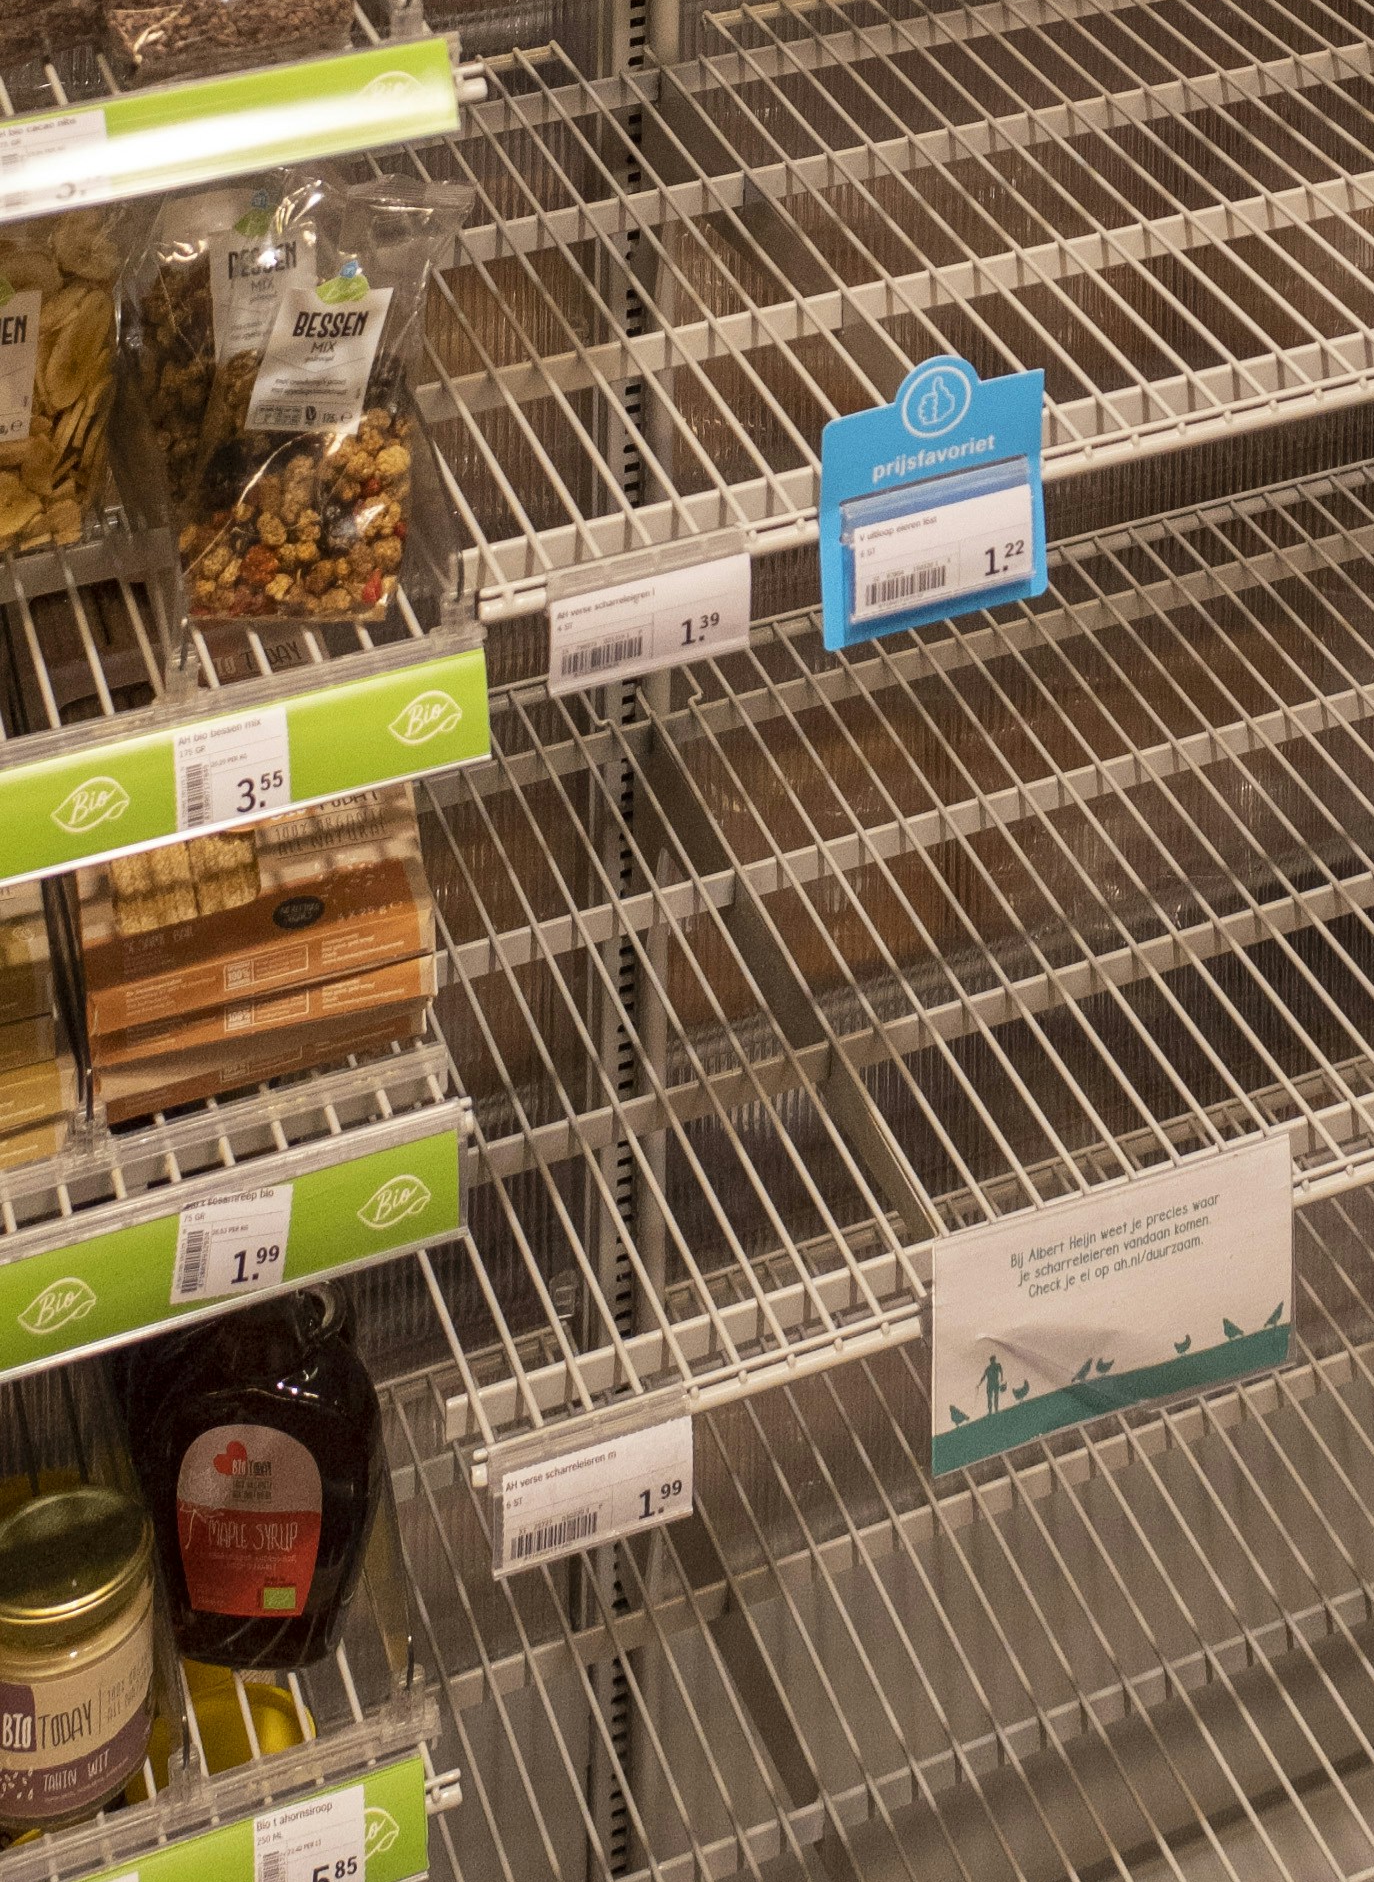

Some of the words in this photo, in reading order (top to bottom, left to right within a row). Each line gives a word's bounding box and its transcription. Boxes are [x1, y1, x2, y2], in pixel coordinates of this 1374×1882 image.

[293, 311, 369, 338] BESSEN
[311, 341, 336, 354] MIX
[872, 434, 995, 485] prijsfavoriet
[984, 539, 1025, 576] 1.22
[594, 589, 651, 611] scharreleieren
[681, 612, 720, 646] 1.39
[178, 735, 191, 746] AH
[193, 730, 208, 743] bio
[210, 723, 243, 739] bessen
[406, 702, 445, 736] Bio
[68, 789, 113, 826] Bio
[236, 770, 284, 813] 3.55
[260, 1187, 274, 1199] bio
[373, 1186, 416, 1222] Bio
[1010, 1254, 1024, 1268] Bij
[1028, 1242, 1064, 1262] Albert
[1069, 1232, 1096, 1251] Heijn
[1100, 1222, 1127, 1239] weet
[1130, 1217, 1142, 1234] je
[1146, 1203, 1188, 1228] precies
[1192, 1195, 1219, 1211] waar
[231, 1245, 280, 1285] 1.99
[1018, 1270, 1030, 1286] je
[1035, 1243, 1119, 1279] scharreleieren
[1123, 1226, 1170, 1250] vandaan
[1029, 1279, 1061, 1298] Check
[1064, 1275, 1075, 1291] je
[1080, 1271, 1091, 1282] ei
[1095, 1265, 1109, 1281] op
[1114, 1235, 1204, 1273] ah.nl/duurzaam.
[38, 1287, 78, 1324] Bio
[505, 1481, 518, 1492] AH
[520, 1473, 543, 1488] verse
[545, 1453, 606, 1479] scharreleieren
[513, 1497, 523, 1507] ST
[638, 1479, 682, 1520] 1.99
[208, 1520, 248, 1550] MAPLE
[253, 1521, 298, 1552] SYRUP
[2, 1711, 33, 1749] BIO
[38, 1699, 92, 1750] TODAY
[43, 1769, 77, 1793] TAHIN
[88, 1749, 110, 1778] WIT
[256, 1819, 270, 1832] Bio
[279, 1801, 333, 1822] ahornsiroop
[257, 1835, 271, 1846] 250
